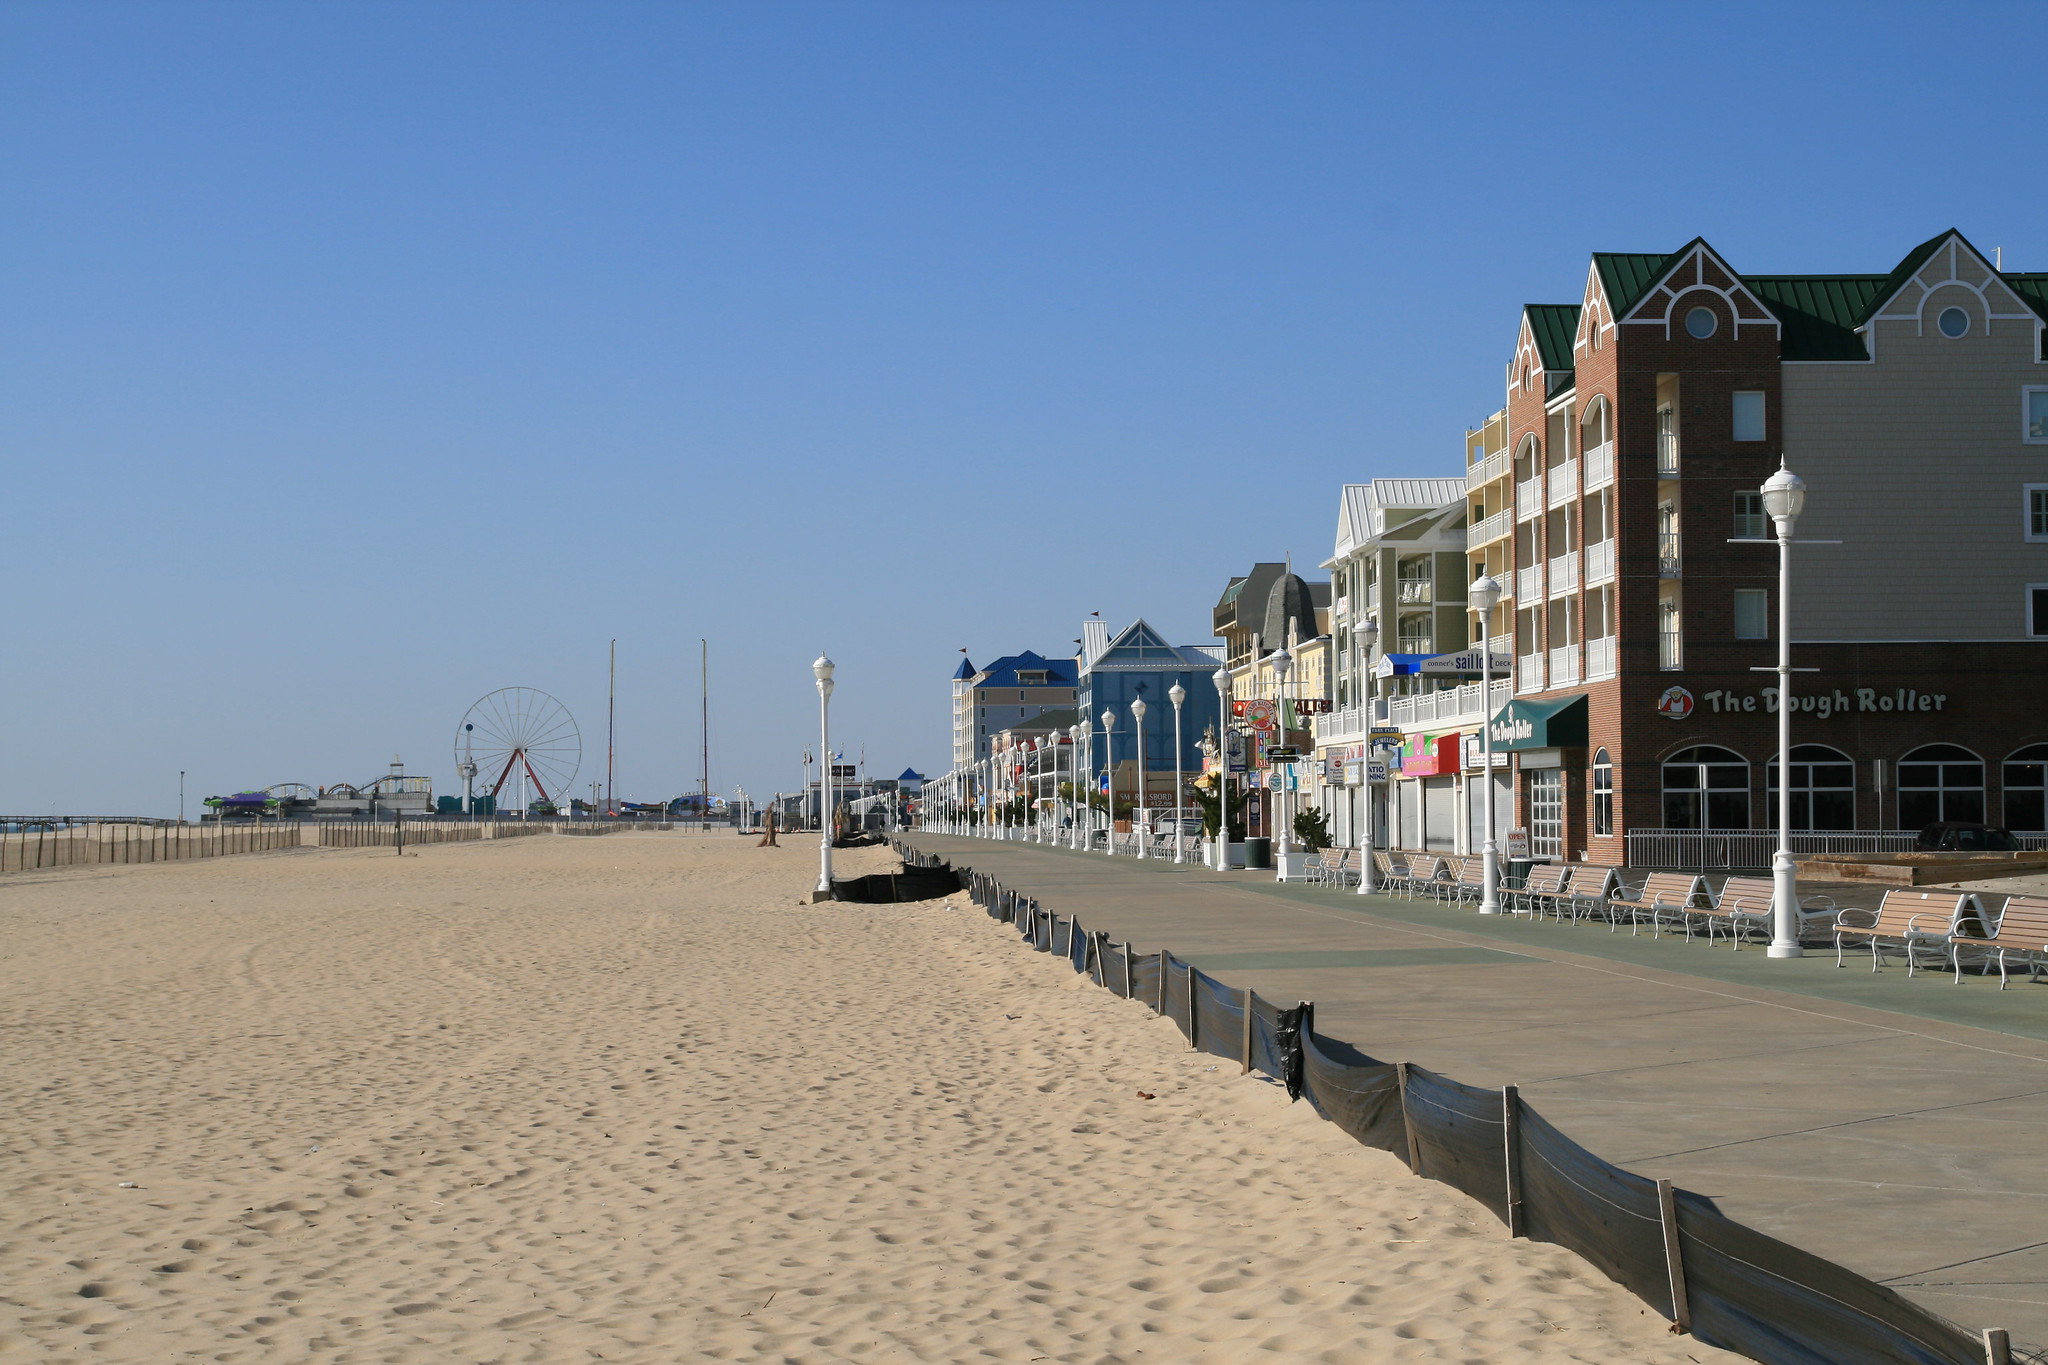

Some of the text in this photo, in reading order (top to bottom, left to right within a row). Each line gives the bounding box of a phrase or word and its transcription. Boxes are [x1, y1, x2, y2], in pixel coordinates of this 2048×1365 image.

[1455, 654, 1473, 669] sail
[1476, 654, 1493, 669] lot
[1703, 687, 1947, 720] The Dough Roller
[1374, 737, 1399, 745] JEWELERS
[1491, 719, 1533, 746] The Dough Roller
